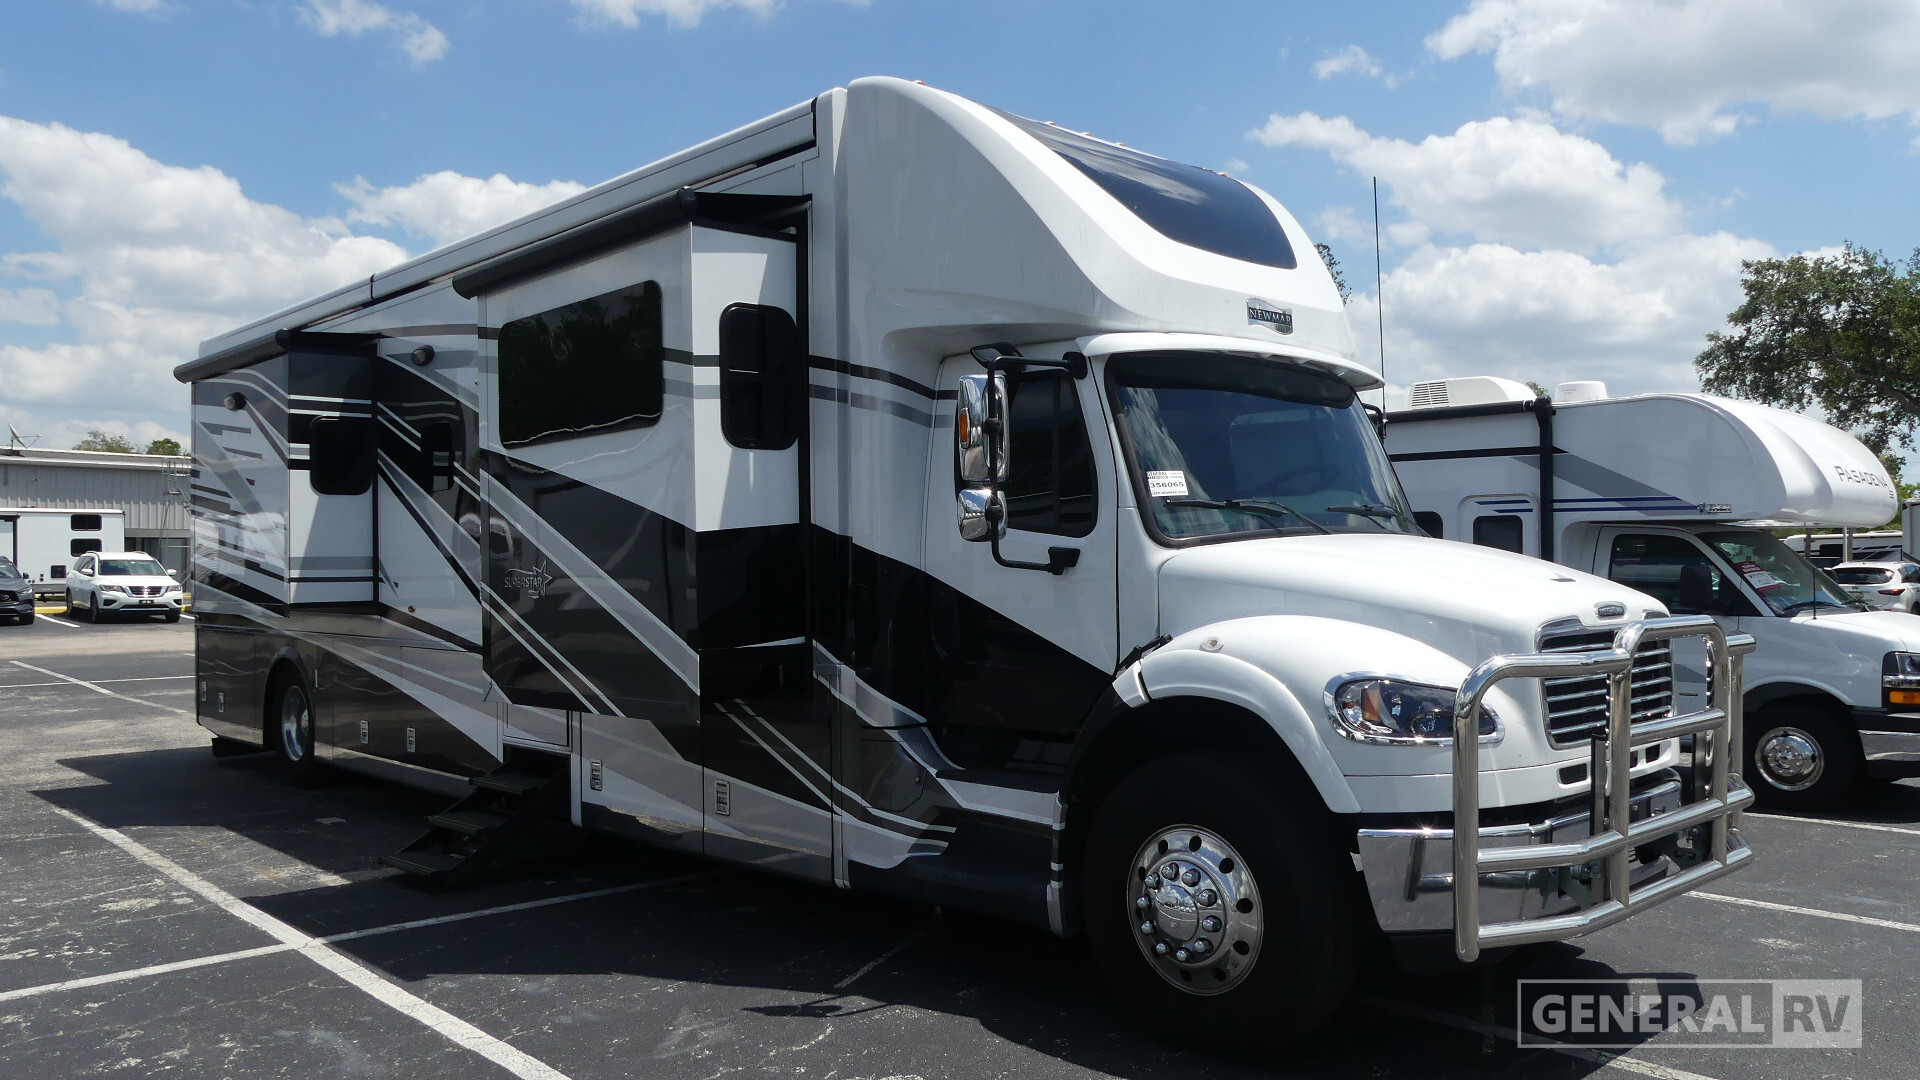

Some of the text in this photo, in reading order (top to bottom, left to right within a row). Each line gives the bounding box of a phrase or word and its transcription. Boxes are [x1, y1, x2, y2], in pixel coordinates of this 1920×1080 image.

[1249, 308, 1291, 325] NEWMAR
[1834, 465, 1890, 489] PASADENA
[504, 576, 543, 588] SUPERSTAR
